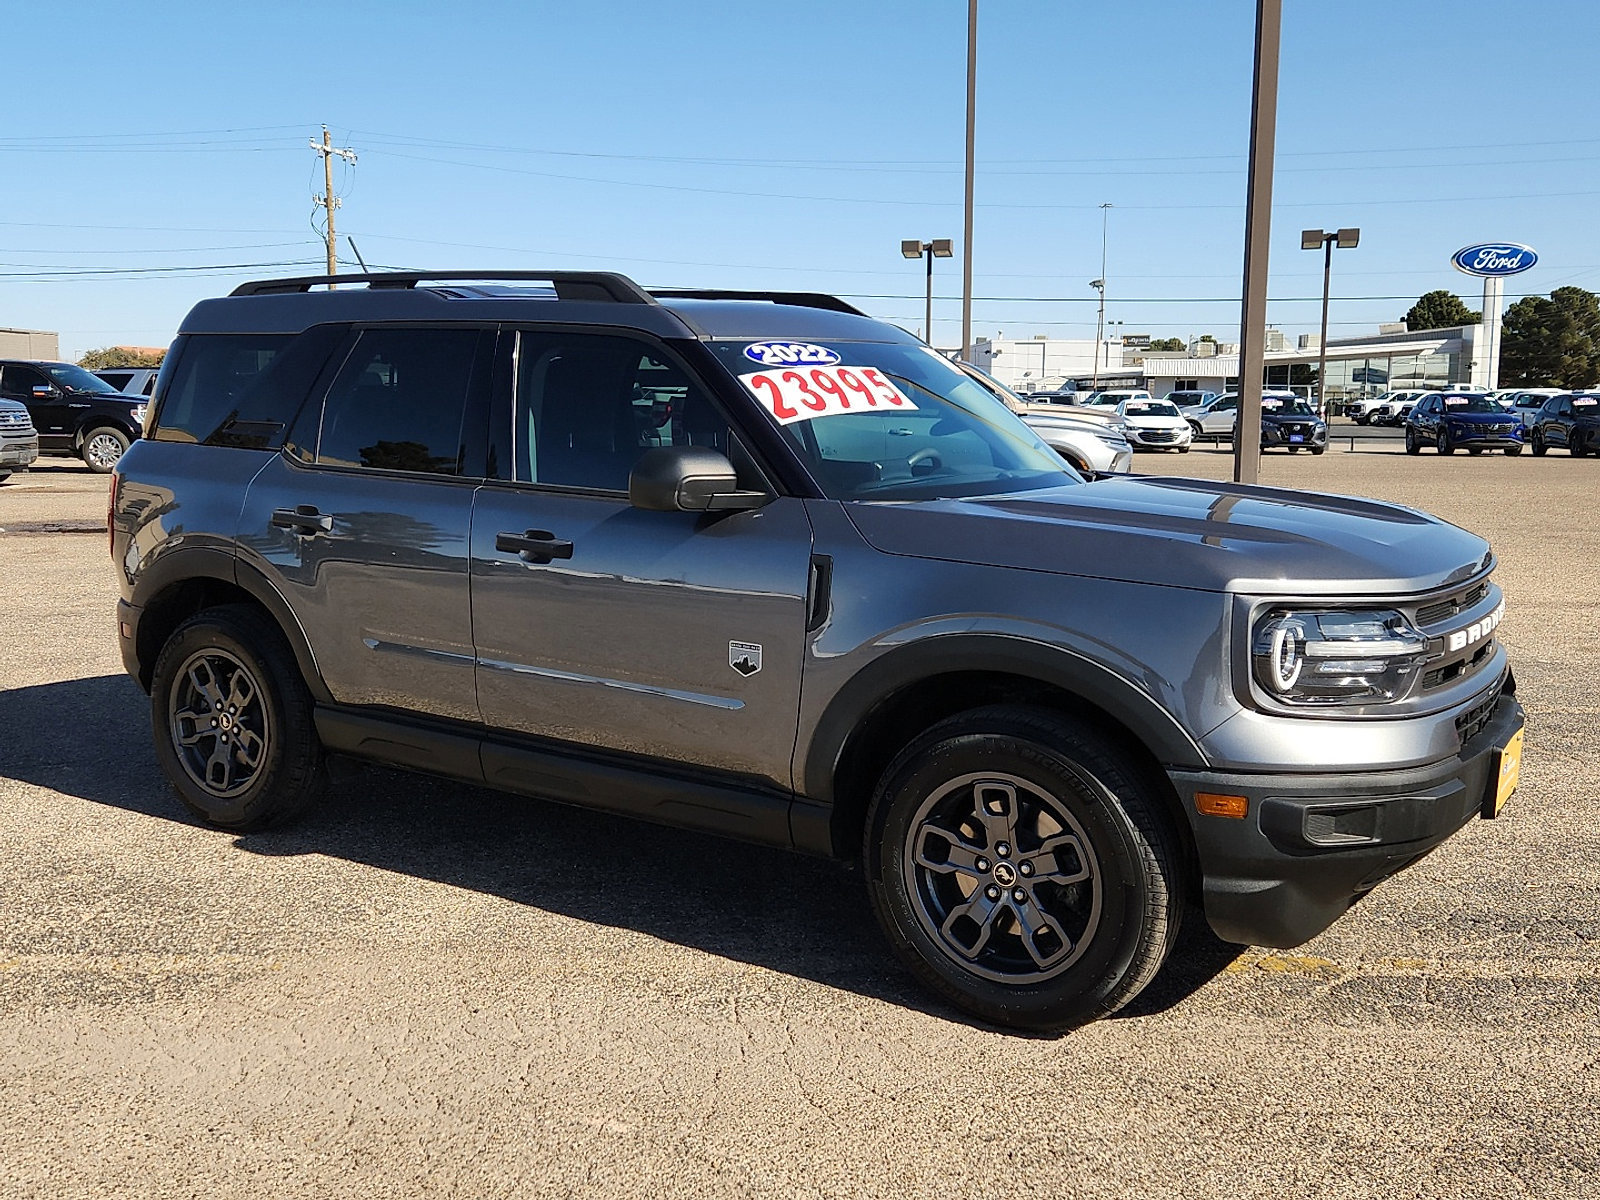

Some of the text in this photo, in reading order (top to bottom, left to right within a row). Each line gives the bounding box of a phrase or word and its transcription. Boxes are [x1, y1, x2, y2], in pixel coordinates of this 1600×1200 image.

[1473, 248, 1523, 269] Ford
[752, 344, 833, 364] 2022
[751, 369, 903, 419] 23995
